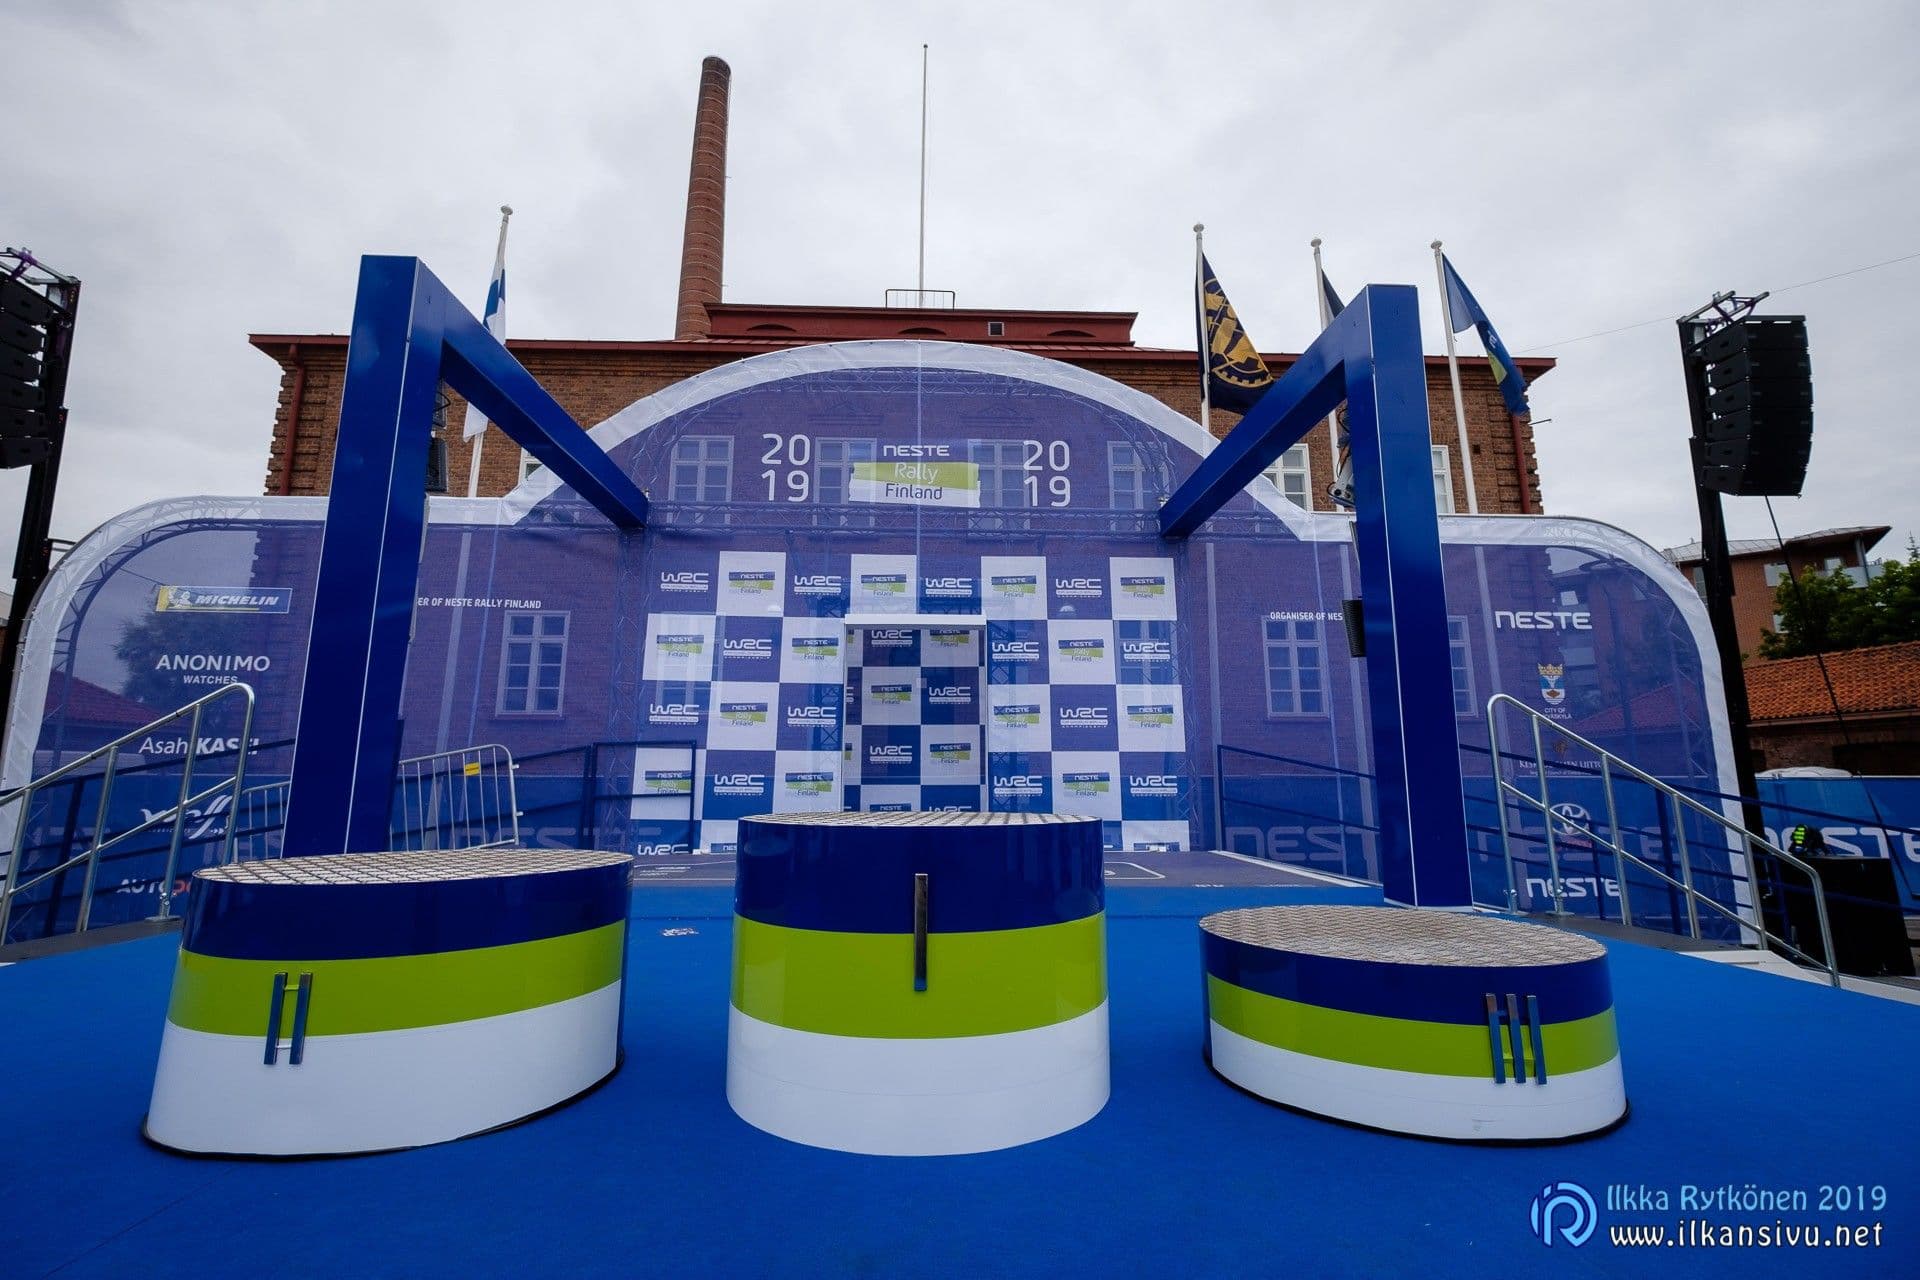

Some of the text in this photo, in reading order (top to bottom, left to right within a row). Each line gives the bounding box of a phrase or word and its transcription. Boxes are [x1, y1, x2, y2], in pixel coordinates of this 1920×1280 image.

[883, 445, 950, 457] NESTE
[894, 462, 938, 484] Rally
[885, 483, 943, 500] Finland
[661, 572, 709, 583] WRC
[794, 575, 841, 586] WRC
[925, 577, 972, 588] WRC
[1055, 578, 1102, 589] WRC
[195, 595, 279, 605] MICHELIN
[431, 597, 443, 606] OF
[444, 598, 473, 607] NESTE
[474, 598, 502, 608] RALLY
[504, 600, 542, 609] FINLAND
[1270, 611, 1343, 620] ORGANISER OF NES
[1494, 610, 1593, 630] NESTE
[871, 629, 912, 639] WRC
[723, 639, 772, 650] WRC
[991, 641, 1039, 652] WRC
[1123, 642, 1170, 653] WRC
[155, 654, 271, 672] ANONIMO
[183, 675, 238, 684] WATCHES
[929, 686, 971, 696] WRC
[650, 703, 700, 715] WRC
[788, 706, 837, 718] WRC
[1060, 707, 1108, 718] WRC
[139, 736, 195, 754] Asah
[870, 745, 912, 755] WRC
[714, 774, 765, 785] WRC
[994, 775, 1042, 786] WRC
[1130, 775, 1178, 786] WRC
[1225, 826, 1384, 862] NEST
